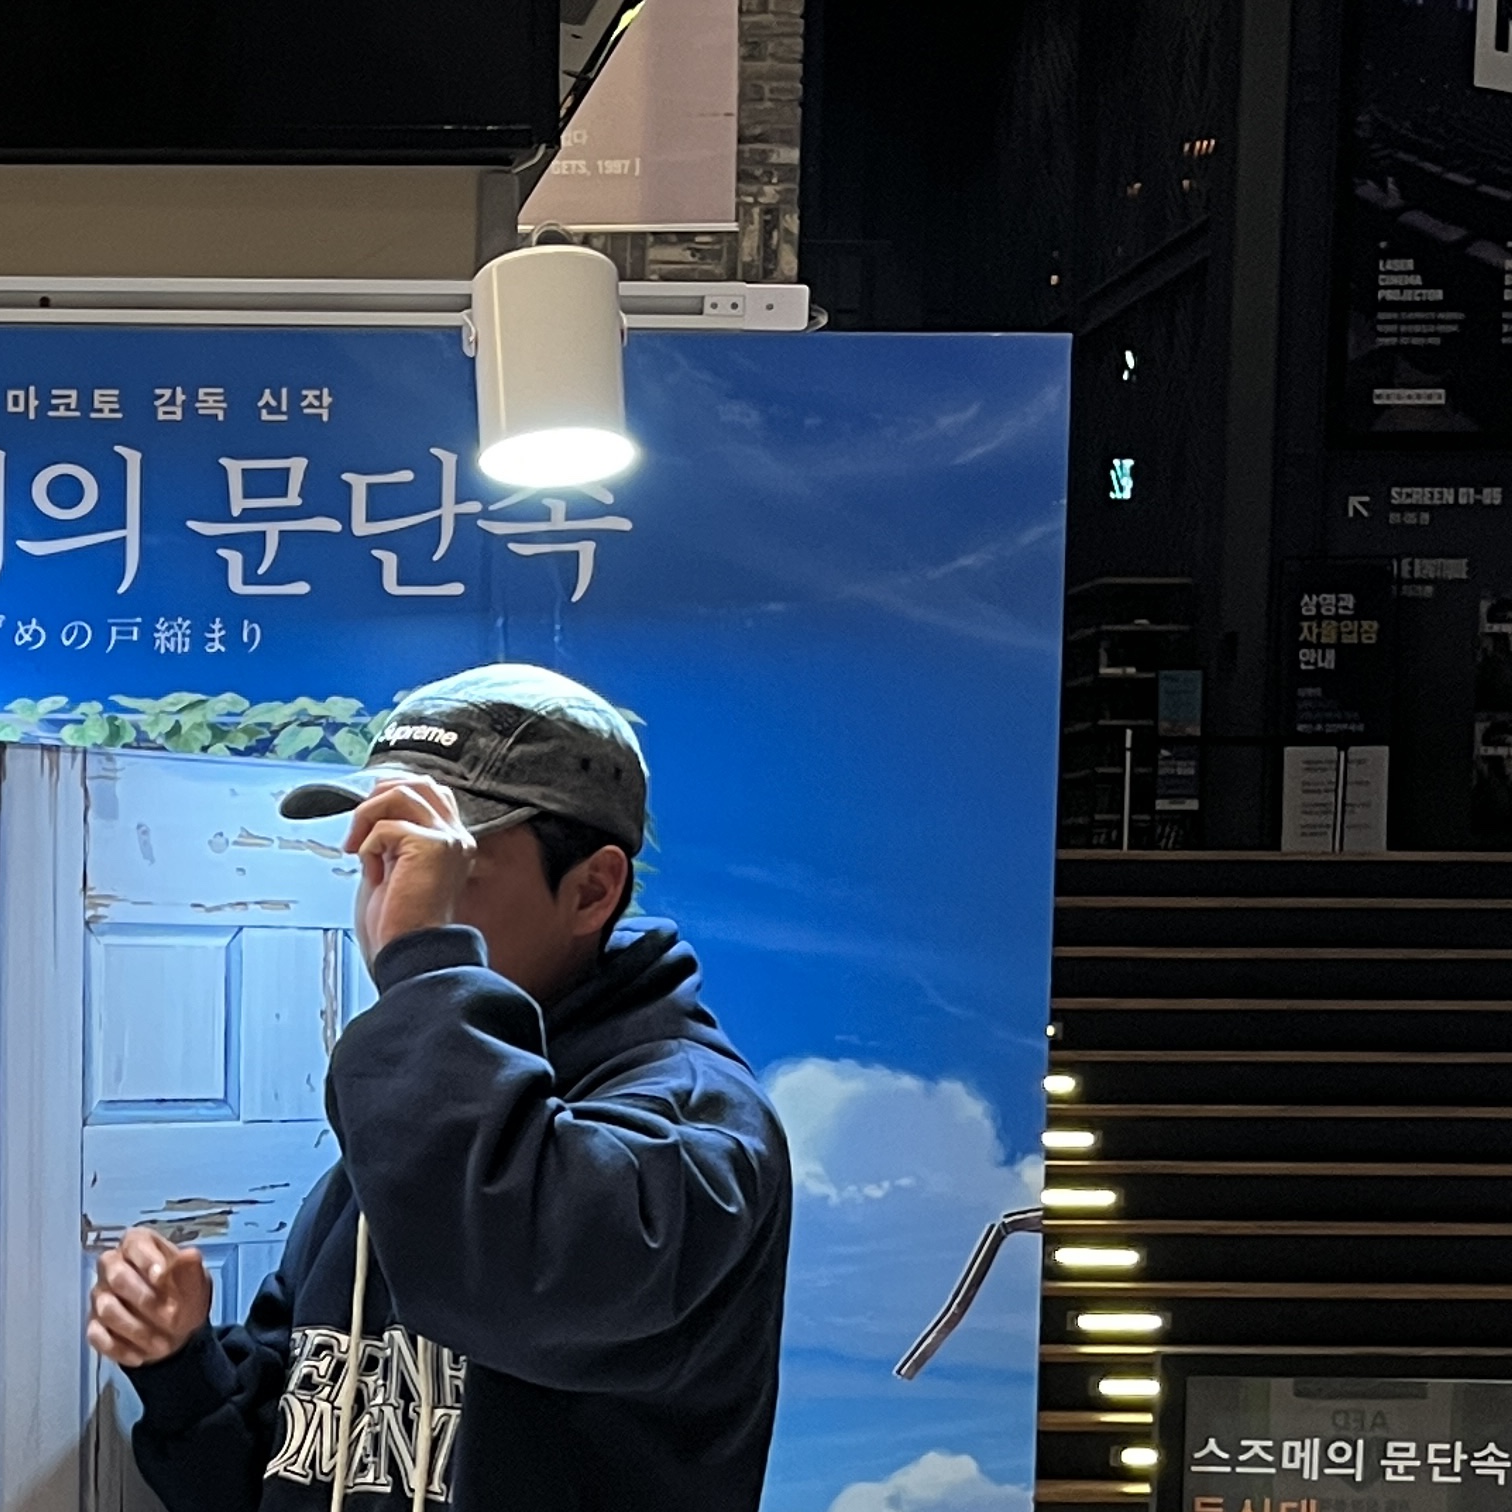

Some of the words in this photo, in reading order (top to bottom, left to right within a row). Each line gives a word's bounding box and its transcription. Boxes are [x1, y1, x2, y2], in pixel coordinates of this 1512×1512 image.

[7, 385, 123, 420] 마코토
[153, 386, 228, 422] 감독
[257, 387, 334, 423] 신작
[1390, 487, 1455, 504] SCREEN
[185, 447, 633, 603] 문단속
[1300, 593, 1355, 616] 상영관
[1299, 648, 1336, 670] 안내
[1190, 1437, 1364, 1482] 스즈메의
[1380, 1440, 1511, 1486] 문단속
